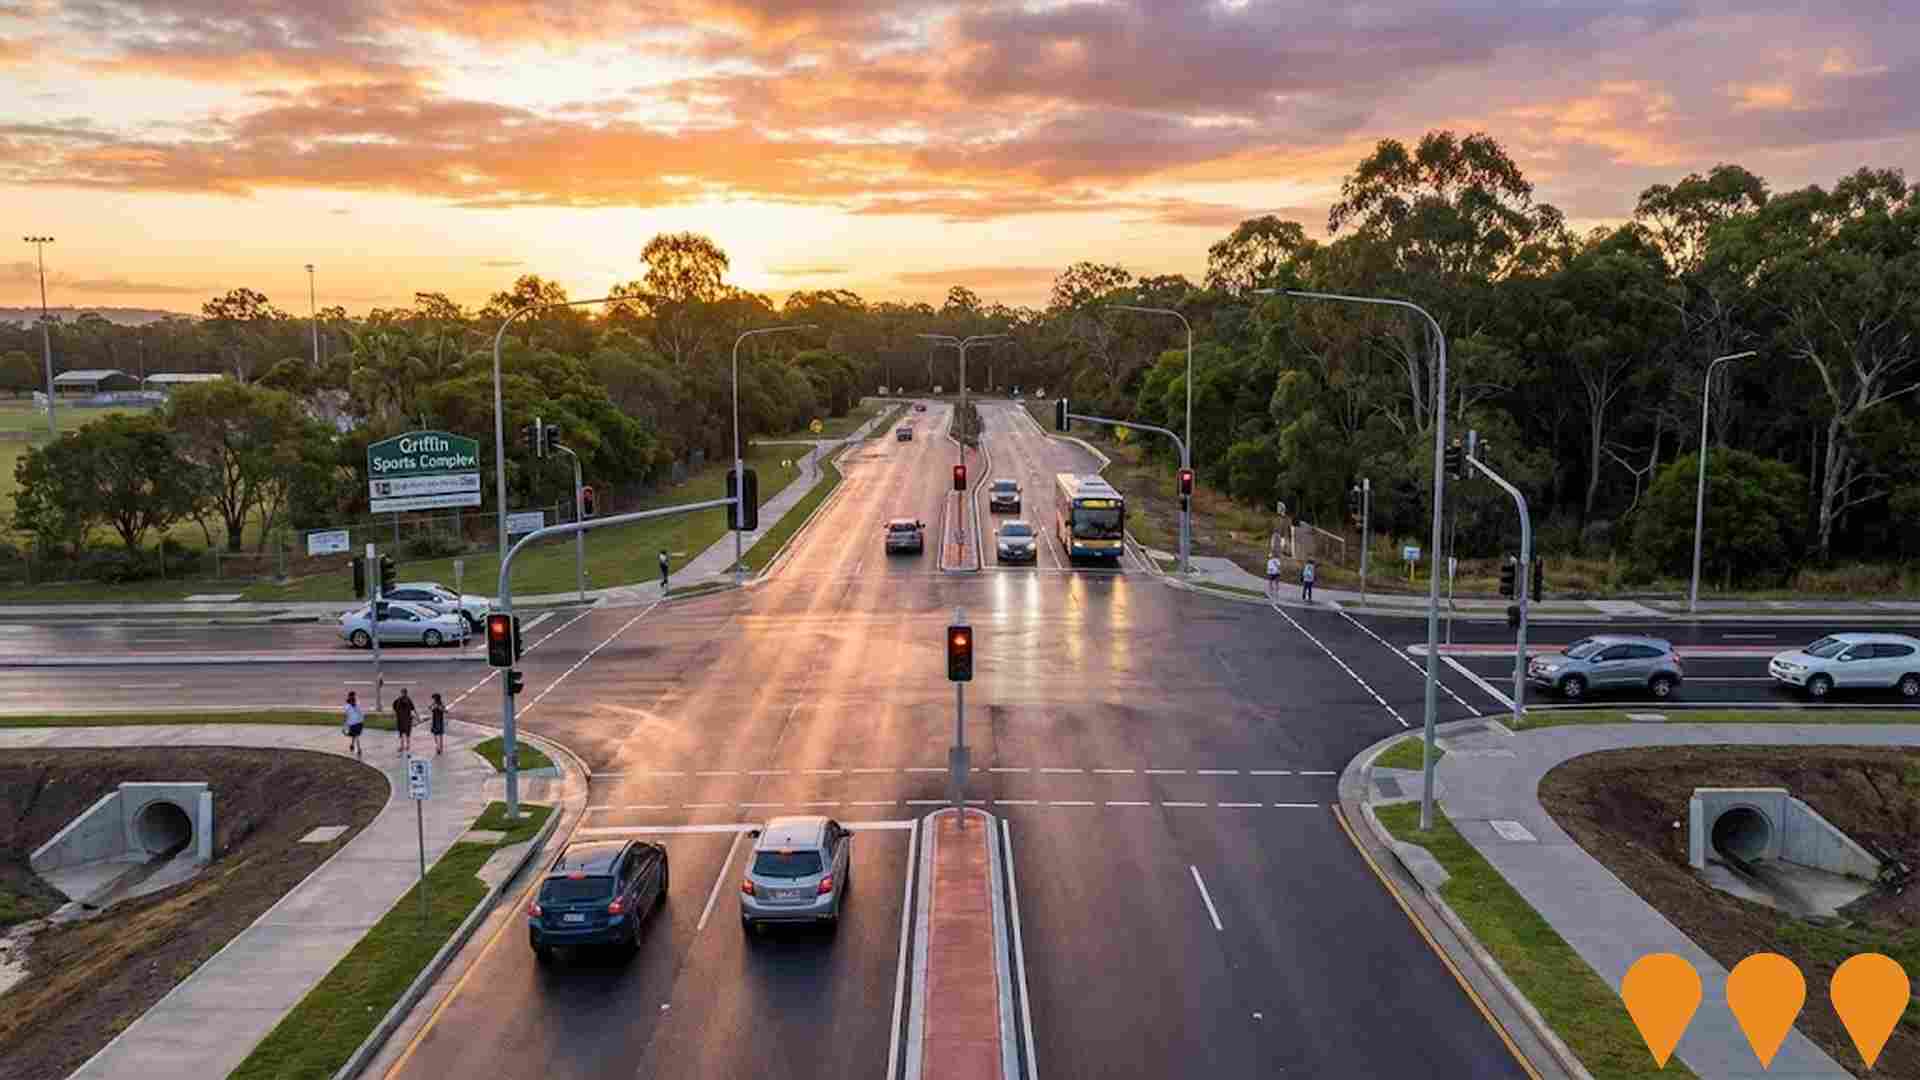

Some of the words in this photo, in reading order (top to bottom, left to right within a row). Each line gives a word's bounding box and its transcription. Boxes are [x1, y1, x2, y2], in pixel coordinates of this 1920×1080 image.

[400, 436, 449, 454] Griffin
[373, 456, 417, 473] Sports
[420, 453, 476, 469] Complex
